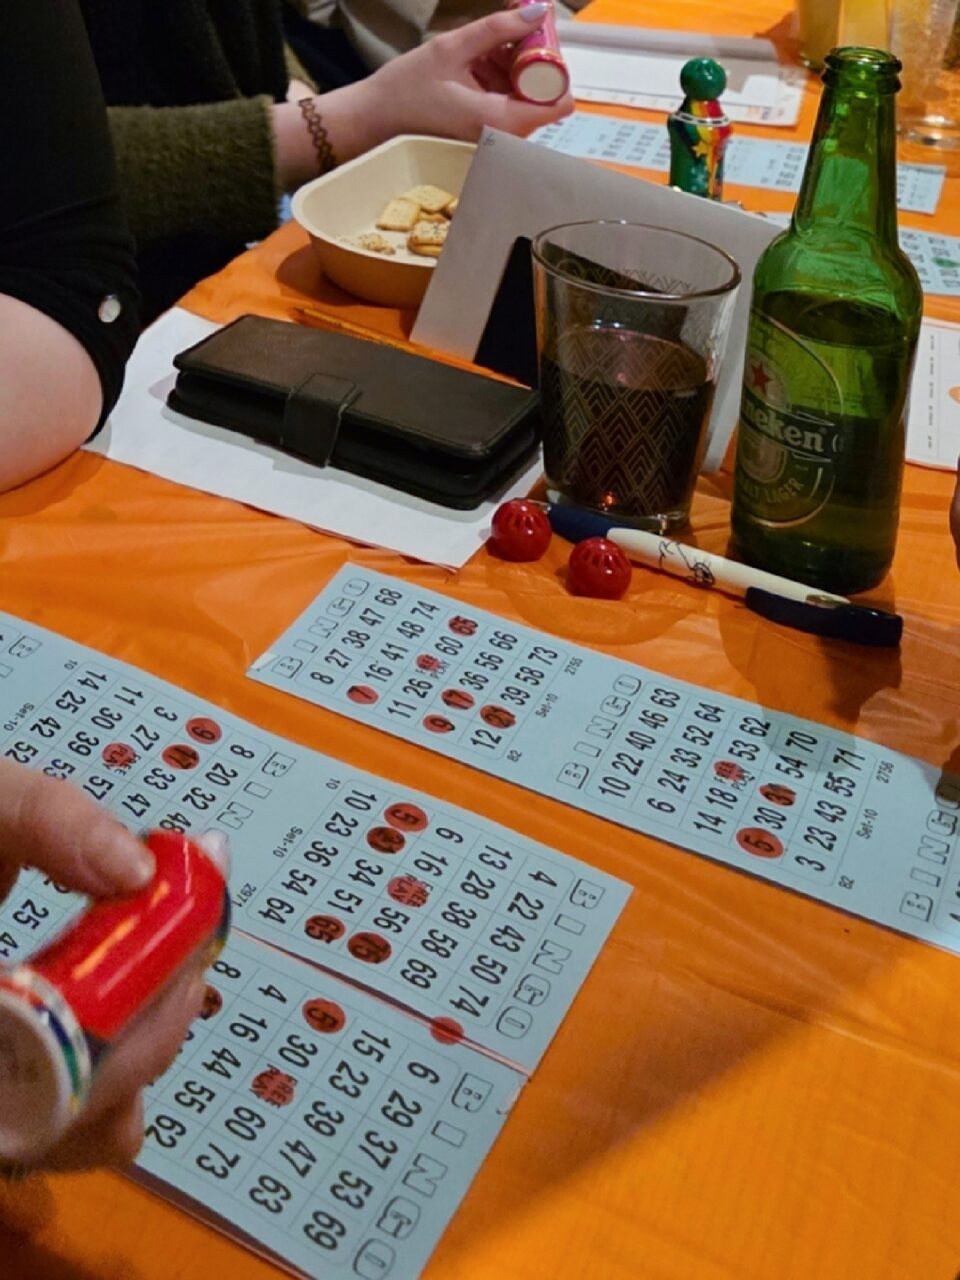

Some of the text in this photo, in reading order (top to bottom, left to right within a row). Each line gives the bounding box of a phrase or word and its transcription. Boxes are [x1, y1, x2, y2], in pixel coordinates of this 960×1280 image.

[766, 477, 804, 503] LAGER
[309, 588, 403, 685] 8 27 38 47 68
[347, 600, 440, 700] 7 16 41 48 74
[387, 616, 479, 719] 11 26 60 65
[430, 630, 519, 731] 9 17 36 56 66
[4, 703, 35, 731] Set-10
[4, 670, 108, 764] 14 25 42 52
[67, 686, 144, 757] 11 30 39
[470, 646, 559, 750] 12 39 58 73
[508, 750, 522, 762] 82
[536, 693, 559, 718] Set-10
[598, 688, 681, 799] 10 22 40 46 63
[784, 730, 818, 754] 70
[82, 706, 178, 801] 3 27 57
[121, 725, 216, 818] 9 17 33 47
[159, 744, 255, 834] 8 20 32 48
[646, 702, 725, 814] 6 24 33 52 64
[692, 716, 772, 835] 14 18 53 62
[774, 754, 809, 779] 54
[273, 826, 302, 858] Set-10
[389, 807, 419, 824] 5
[744, 834, 775, 852] 5
[753, 807, 787, 830] 30
[794, 747, 866, 872] 3 23 43 55 71
[839, 876, 854, 889] 82
[856, 809, 878, 839] Set-10
[234, 883, 257, 908] 2971
[257, 789, 378, 925] 10 23 36 54 64
[327, 888, 364, 914] 51
[347, 858, 384, 888] 34
[372, 827, 464, 934] 6 16 56
[12, 898, 50, 930] 25
[399, 844, 513, 990] 13 28 38 58 69
[449, 870, 558, 1018] 4 22 43 50 74
[213, 961, 241, 979] 8
[145, 984, 288, 1149] 4 16 44 55 62
[195, 1006, 337, 1180] 5 30 60 73
[248, 1029, 392, 1214] 15 23 39 47 63
[303, 1061, 440, 1251] 6 29 37 53 69
